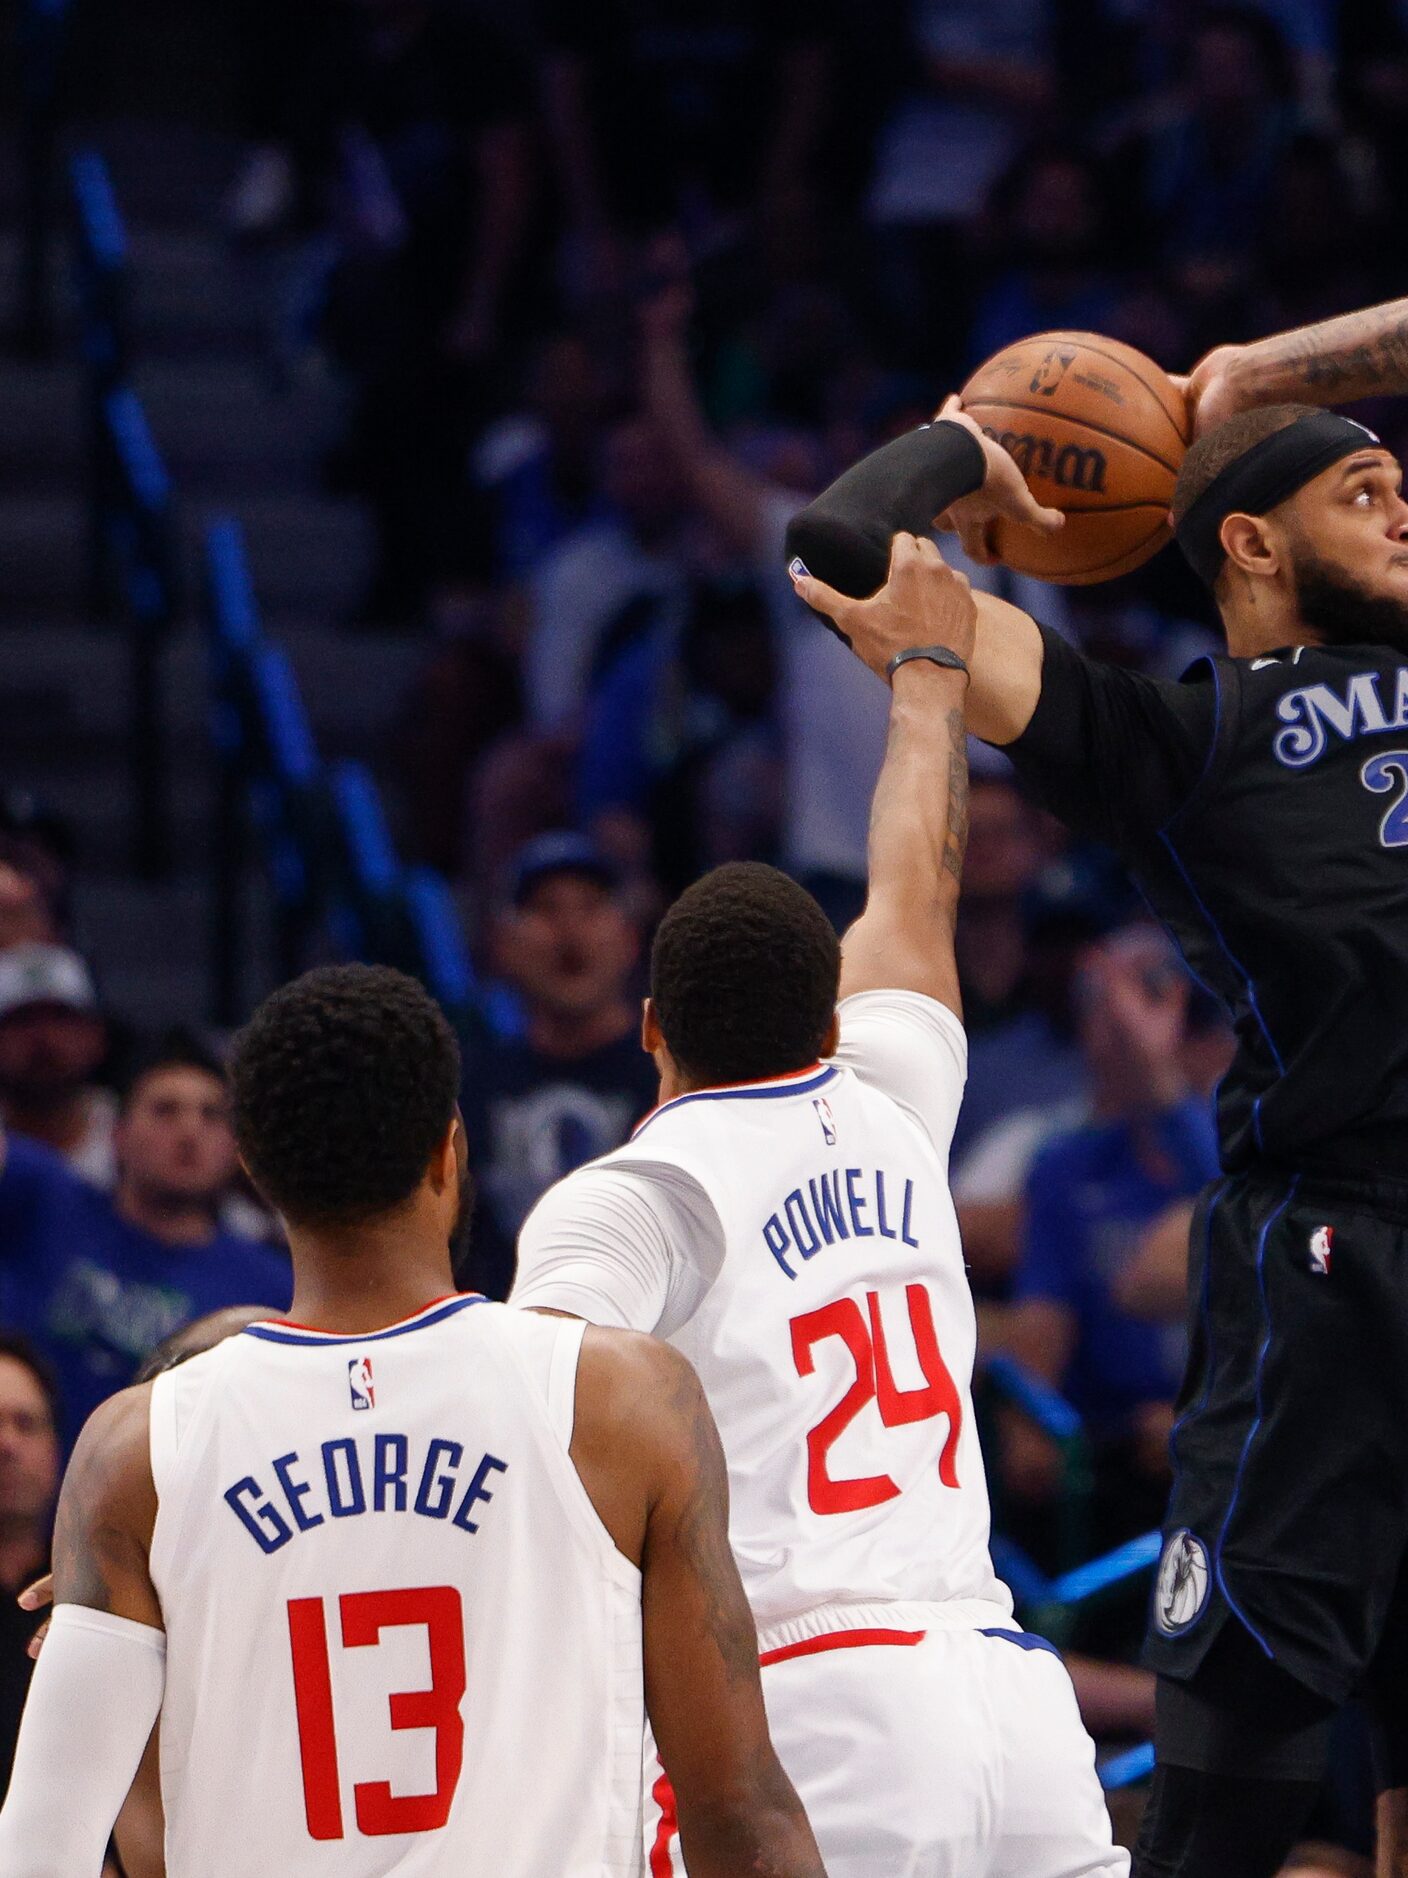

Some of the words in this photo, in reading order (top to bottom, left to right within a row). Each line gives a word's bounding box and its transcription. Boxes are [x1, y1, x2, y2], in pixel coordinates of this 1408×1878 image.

[763, 1168, 920, 1281] POWELL
[790, 1283, 962, 1516] 24
[223, 1433, 508, 1554] GEORGE
[287, 1585, 467, 1841] 13
